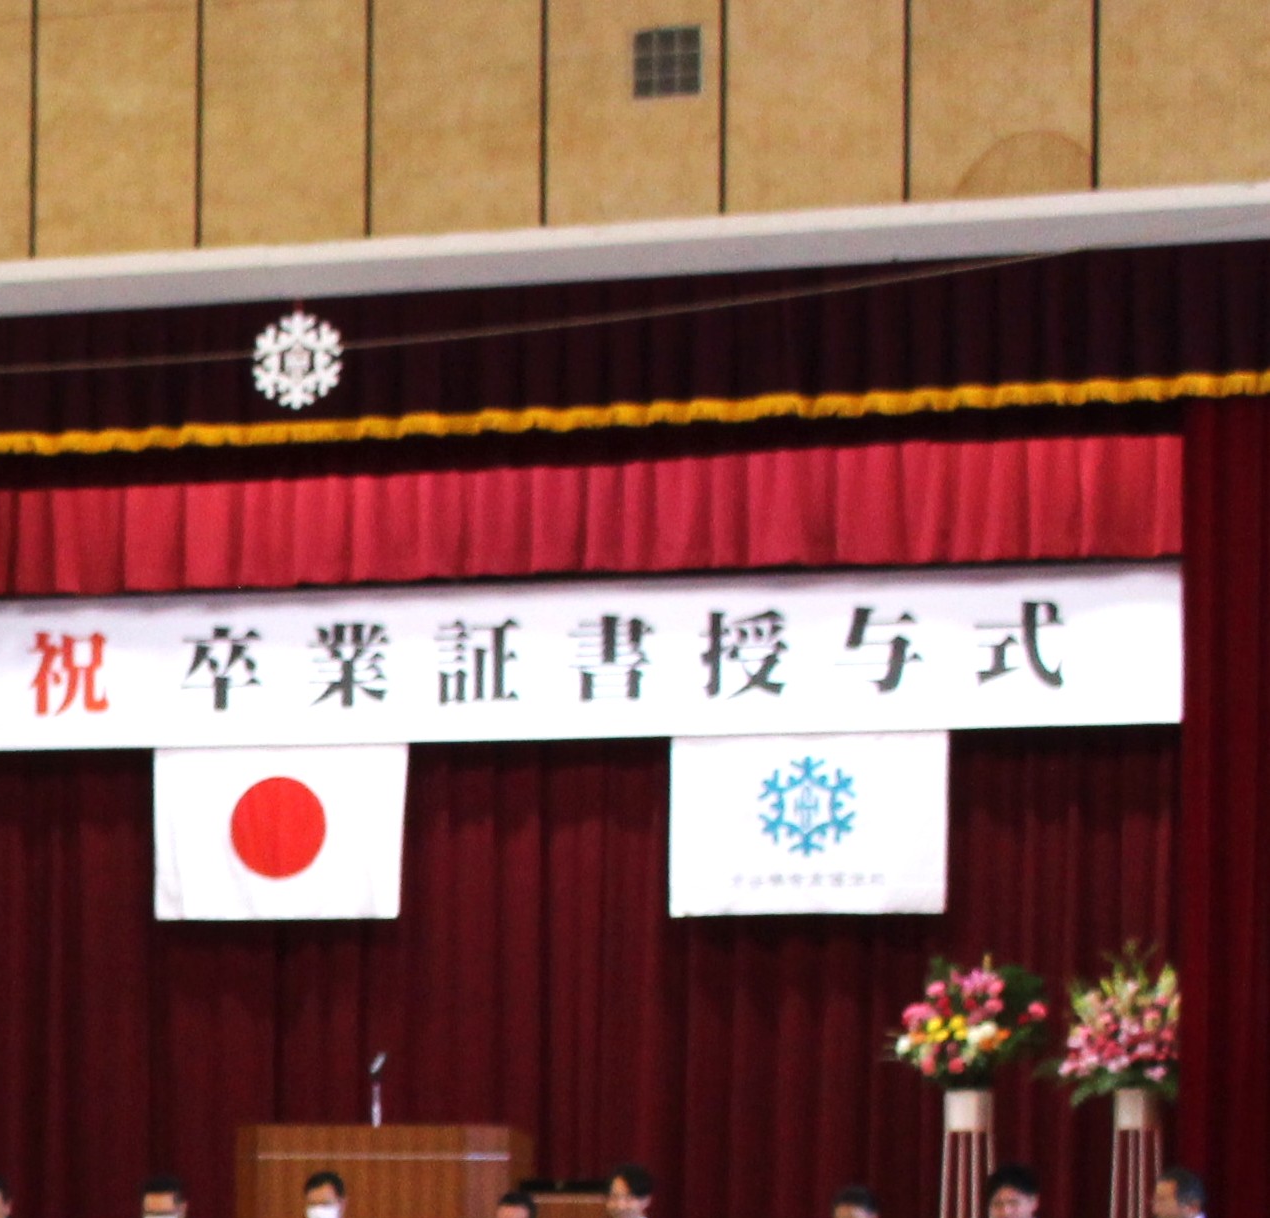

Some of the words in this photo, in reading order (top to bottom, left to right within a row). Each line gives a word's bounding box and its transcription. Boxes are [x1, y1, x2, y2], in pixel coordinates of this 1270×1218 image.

[29, 631, 109, 716] 祝
[181, 601, 1064, 711] 卒業証書授与式
